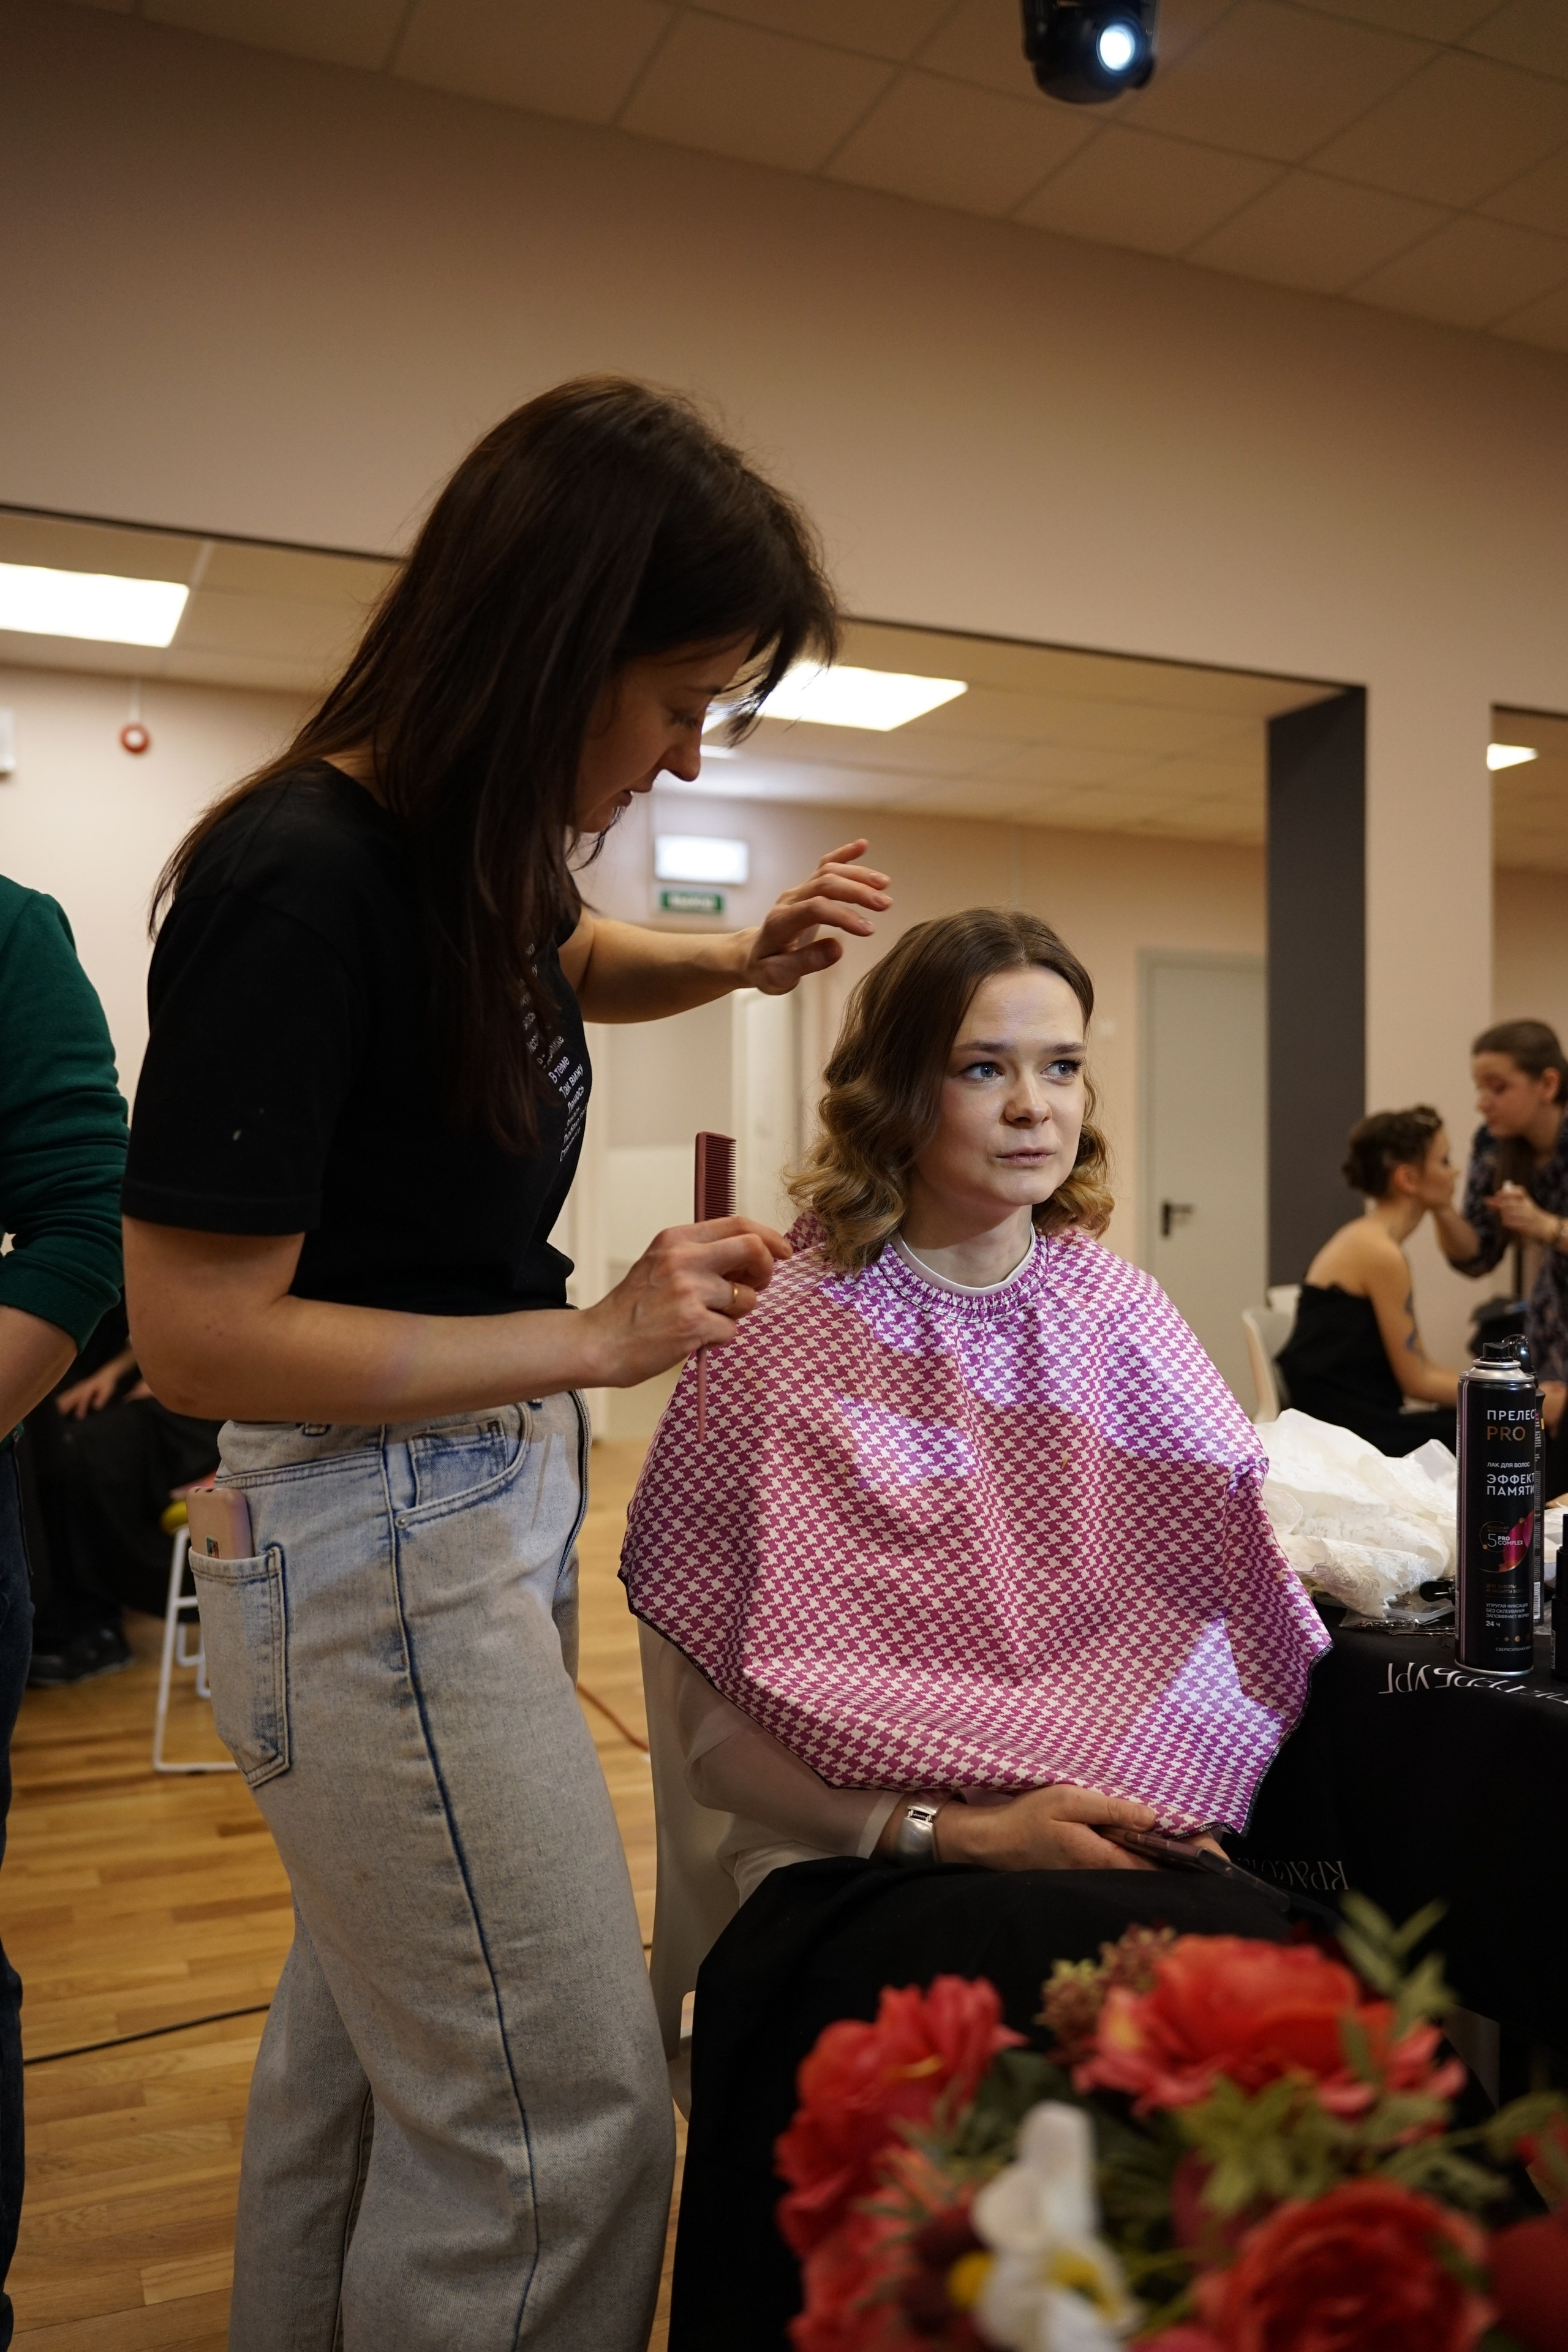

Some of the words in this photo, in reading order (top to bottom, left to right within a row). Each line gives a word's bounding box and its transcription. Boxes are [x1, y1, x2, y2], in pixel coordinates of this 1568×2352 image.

[548, 1072, 557, 1084] В
[554, 1056, 570, 1077] теме
[559, 1081, 571, 1099] Так
[568, 1063, 583, 1087] вижу
[1487, 1409, 1536, 1421] ПРЕЛЕС
[1487, 1425, 1526, 1442] PRO
[1487, 1472, 1535, 1485] ЭФФЕКТ
[1487, 1485, 1535, 1496] ПАМЯТИ
[1487, 1533, 1497, 1547] 5
[1238, 1858, 1350, 1891] КРАСО
